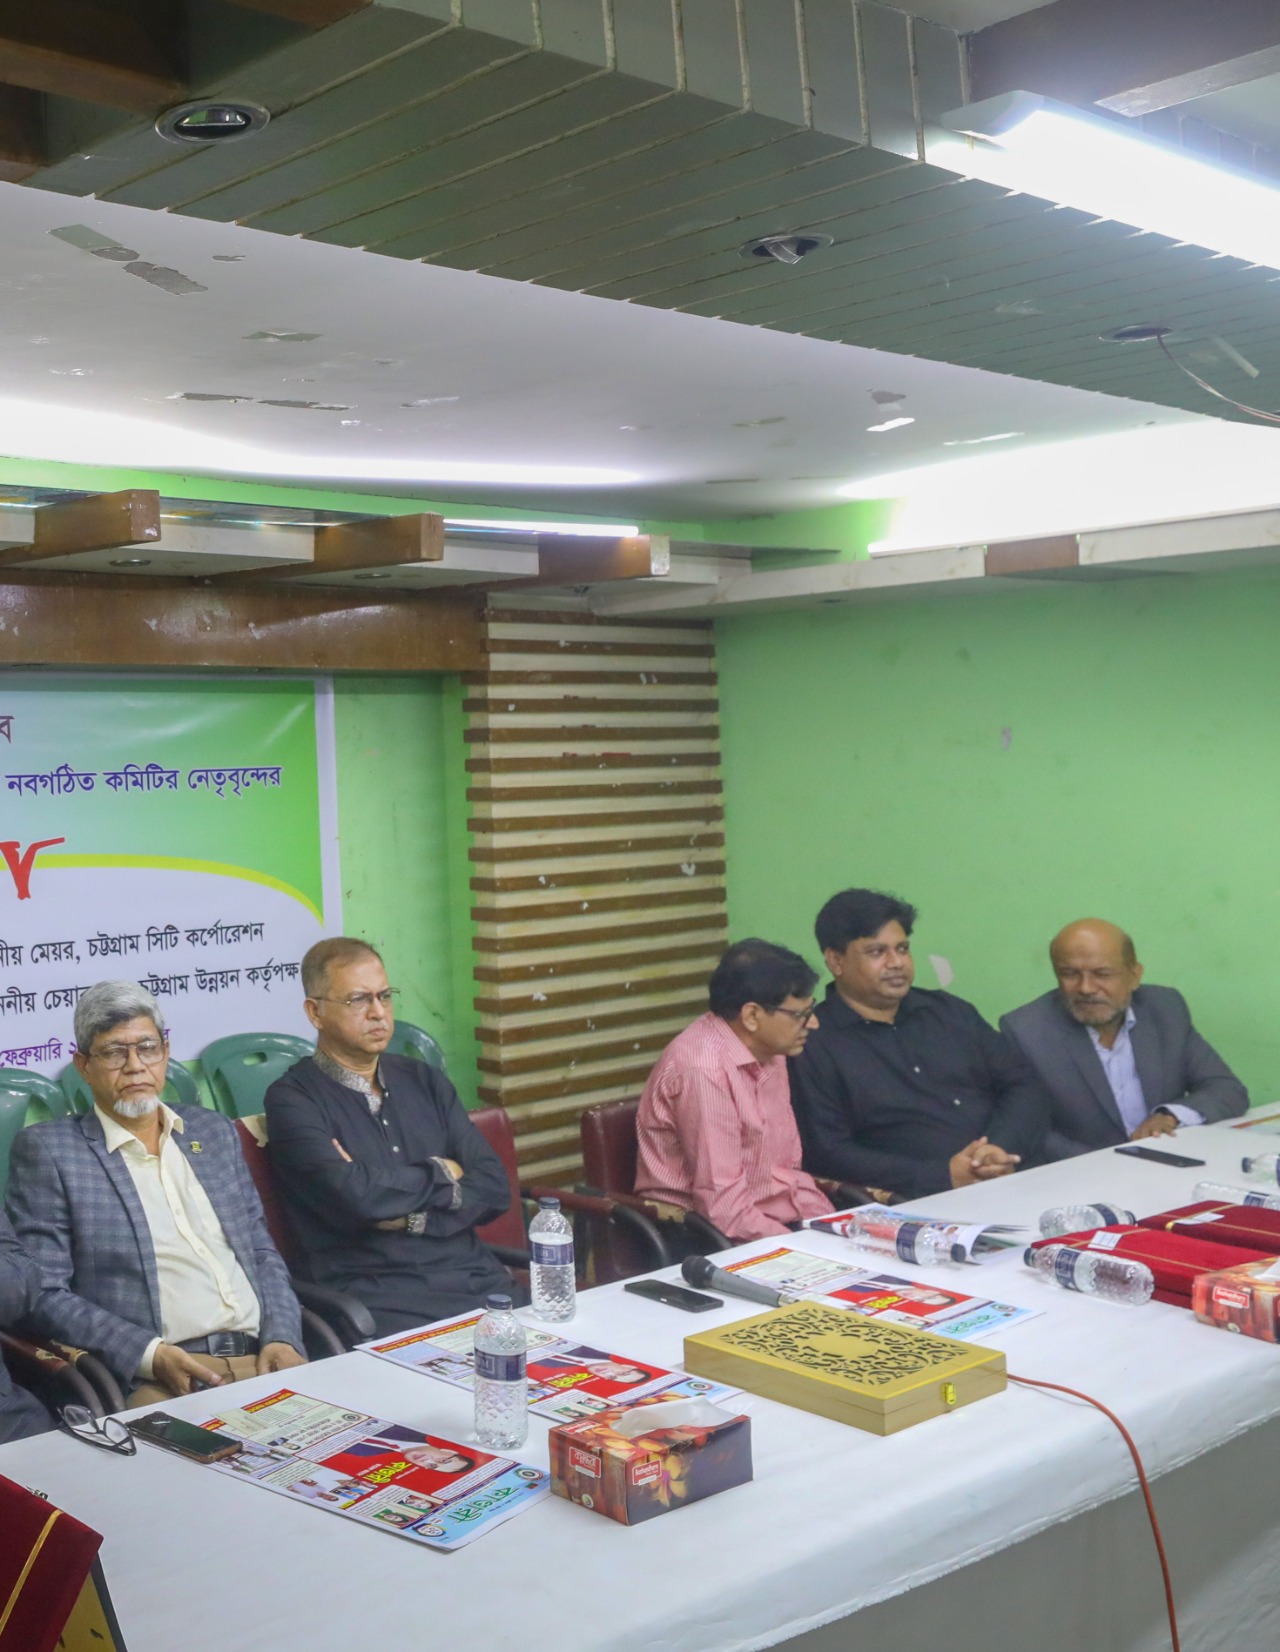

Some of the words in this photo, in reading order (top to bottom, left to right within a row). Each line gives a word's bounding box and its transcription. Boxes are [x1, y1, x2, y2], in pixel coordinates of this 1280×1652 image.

[5, 763, 97, 797] নবগঠিত
[103, 763, 179, 793] কমিটির
[188, 766, 282, 797] নেতৃবৃন্দের
[31, 941, 80, 964] মেয়র,
[87, 931, 140, 957] চট্টগ্রাম
[146, 924, 179, 952] সিটি
[185, 918, 265, 948] কর্পোরেশন
[195, 966, 241, 994] উন্নয়ন
[245, 957, 300, 993] কর্তৃপক্ষ
